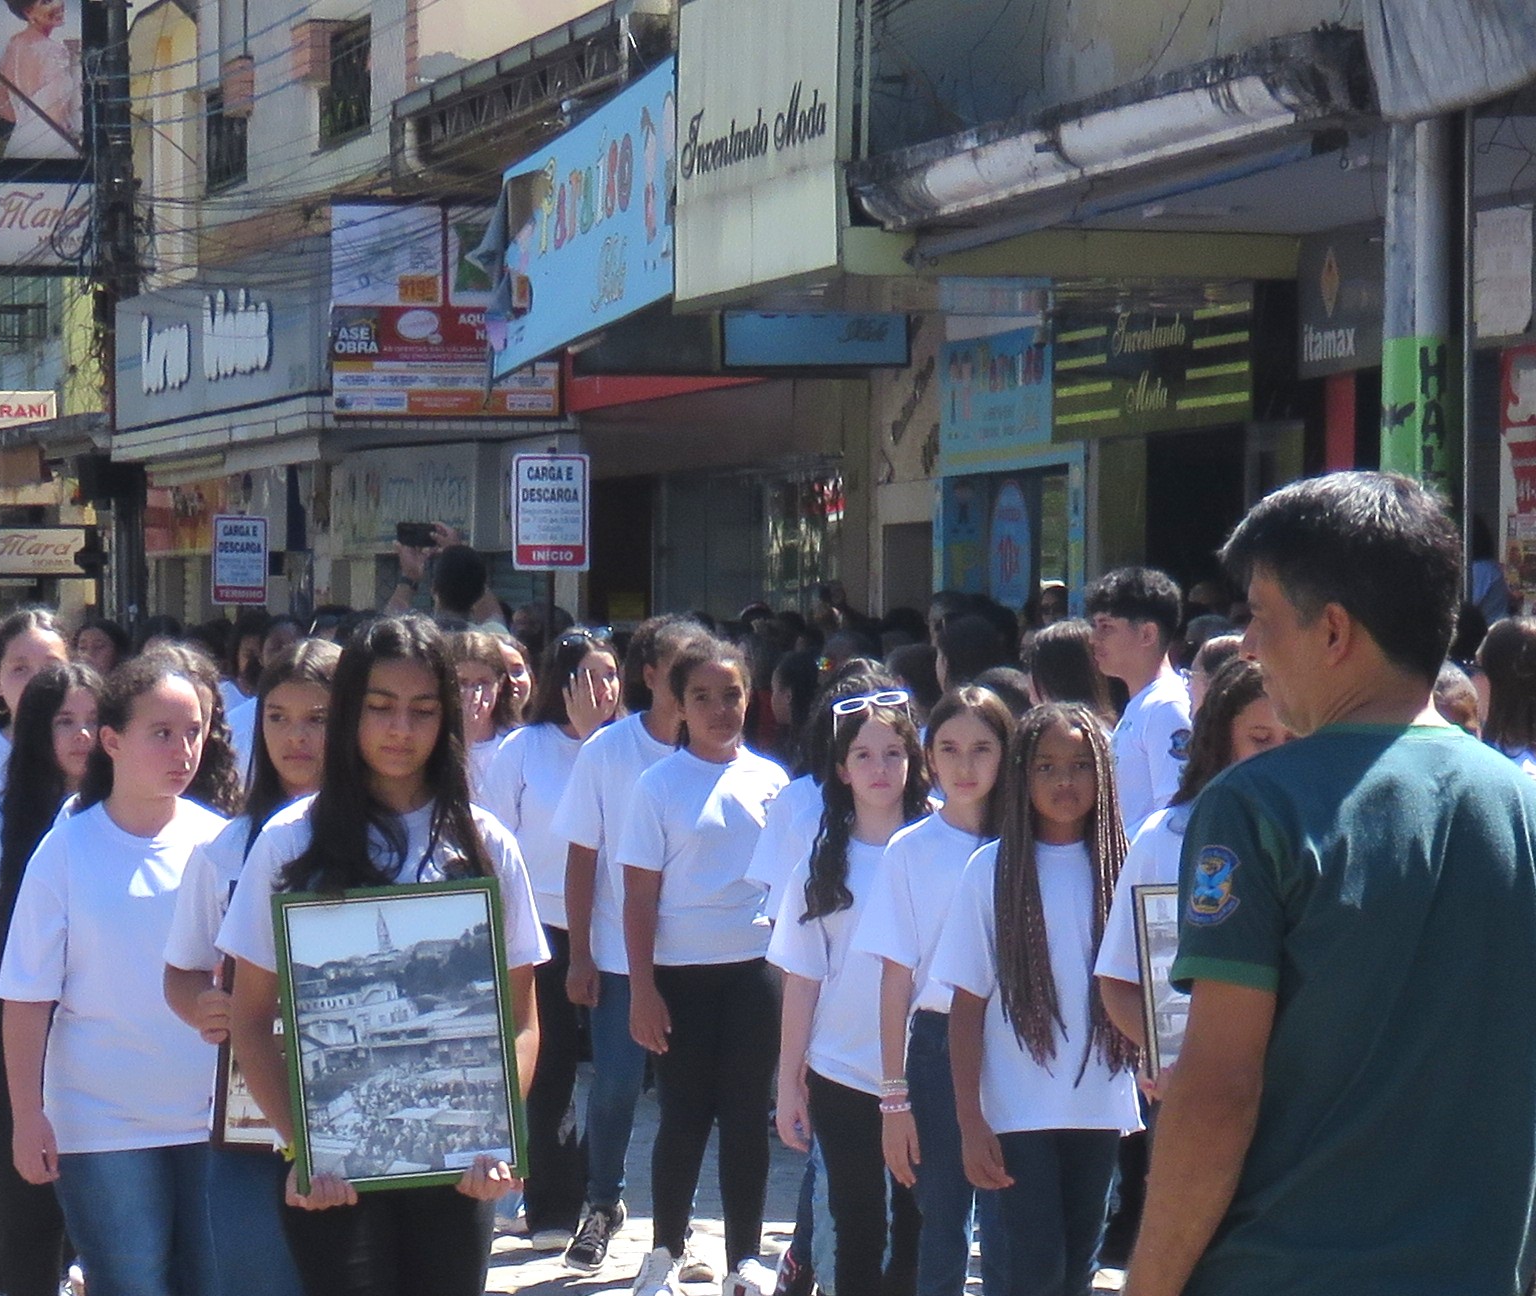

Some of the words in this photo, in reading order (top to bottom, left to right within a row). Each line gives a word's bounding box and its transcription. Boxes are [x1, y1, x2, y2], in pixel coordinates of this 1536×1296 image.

[680, 106, 768, 181] Inventando
[773, 80, 827, 148] Moda
[334, 341, 379, 354] OBRA
[1303, 323, 1356, 363] itamax
[527, 466, 563, 481] CARGA
[566, 466, 574, 481] E
[521, 487, 579, 502] DESCARGA
[223, 525, 250, 537] CARGA
[218, 541, 262, 553] DESCARGA
[532, 548, 574, 561] INÍCIO
